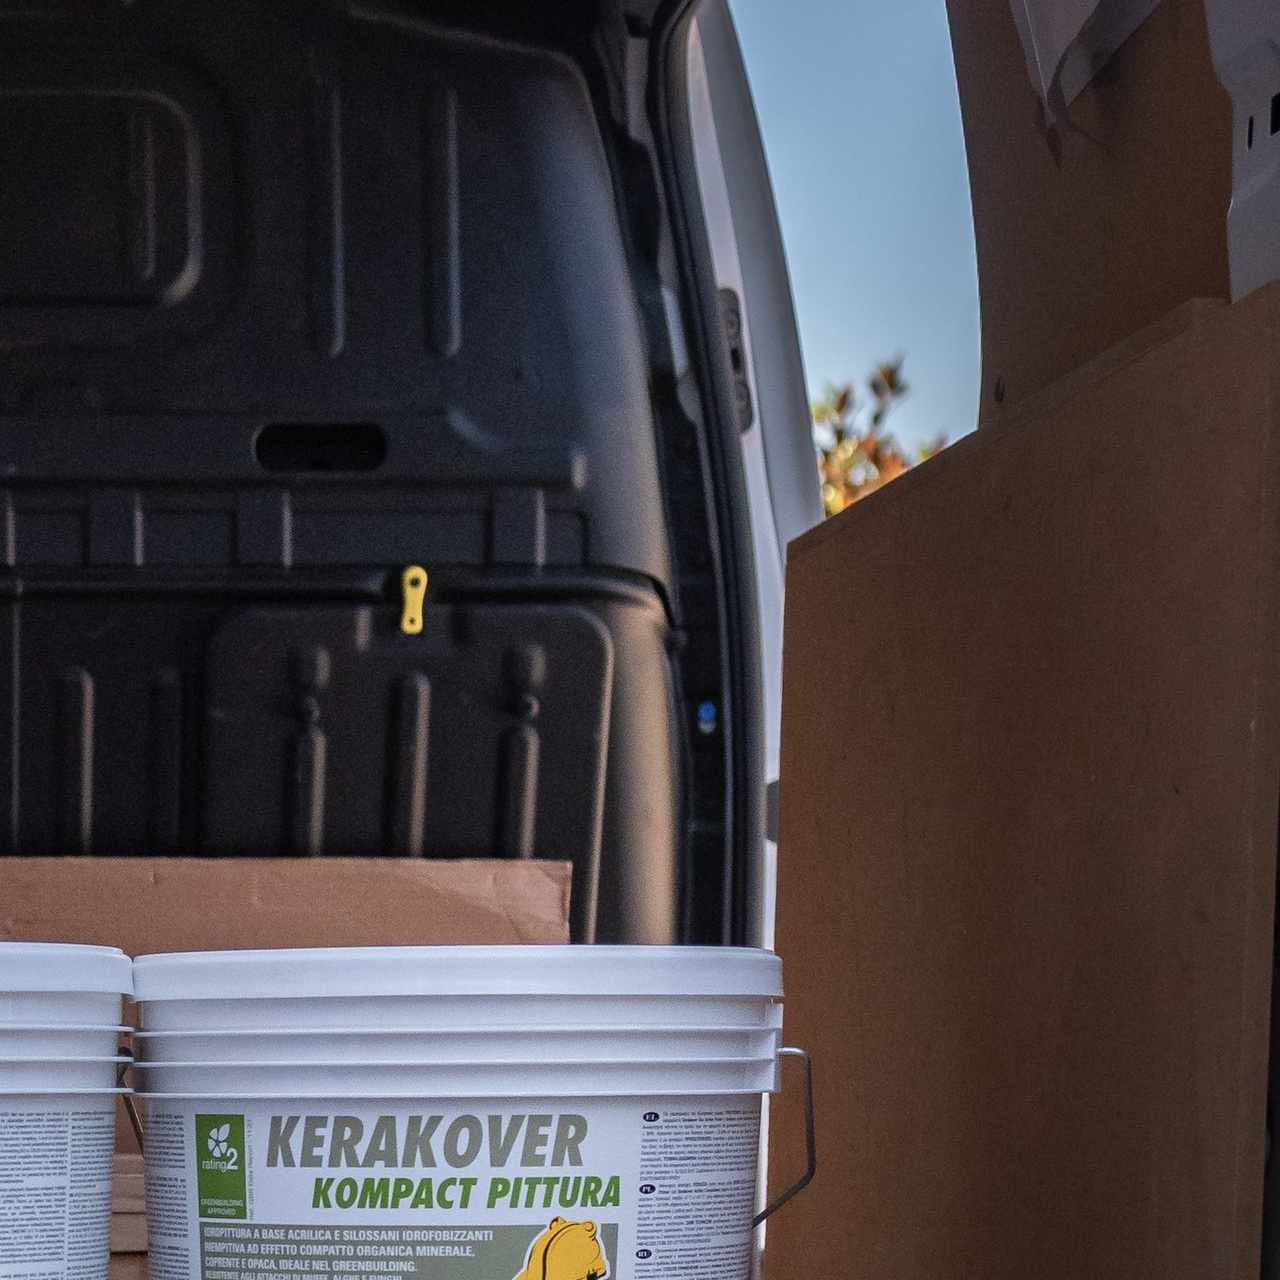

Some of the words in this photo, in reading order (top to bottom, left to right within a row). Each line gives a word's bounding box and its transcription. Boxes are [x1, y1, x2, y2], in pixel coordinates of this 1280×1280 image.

[266, 1115, 588, 1168] KERAKOVER
[312, 1177, 478, 1209] KOMPACT
[486, 1176, 620, 1209] PITTURA
[204, 1227, 252, 1238] IDROPITTURA
[262, 1230, 285, 1239] BASE
[288, 1230, 331, 1241] ACRILICA
[343, 1230, 399, 1241] SILOSSANI
[403, 1230, 493, 1241] IDROFOBIZZANTI
[205, 1242, 245, 1253] RIEMPITIVA
[247, 1244, 258, 1254] AD
[261, 1245, 295, 1255] EFFETTO
[300, 1245, 354, 1256] COMPATTO
[357, 1246, 413, 1256] ORGANICA
[205, 1257, 240, 1268] COPRENTE
[279, 1260, 310, 1270] IDEALE
[312, 1261, 330, 1270] NEL
[206, 1271, 239, 1280] RESISTENTE
